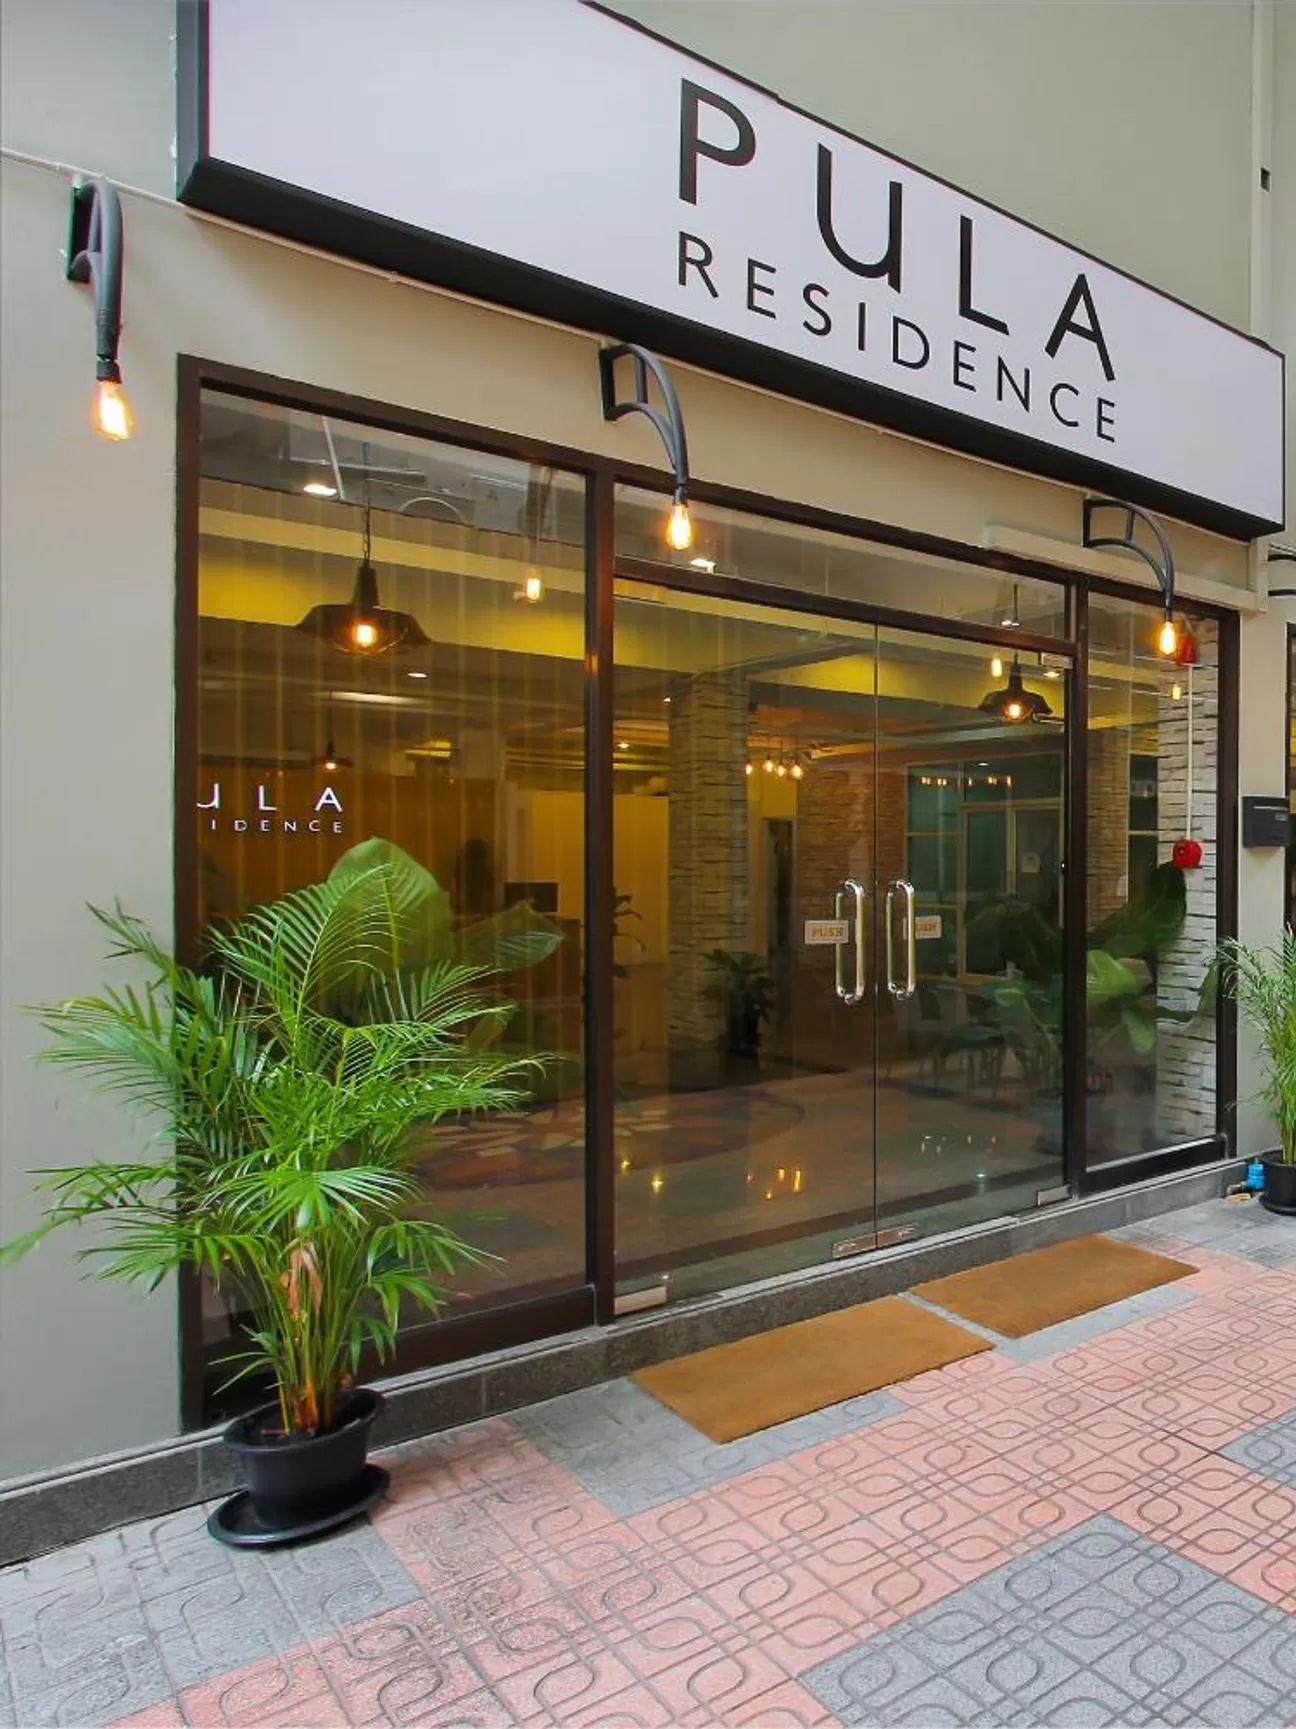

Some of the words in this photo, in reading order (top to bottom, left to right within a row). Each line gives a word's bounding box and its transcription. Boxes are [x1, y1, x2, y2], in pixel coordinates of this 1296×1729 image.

[679, 77, 1117, 383] PULA
[678, 230, 1116, 443] RESIDENCE
[197, 782, 343, 813] ULA
[211, 819, 343, 834] IDENCE
